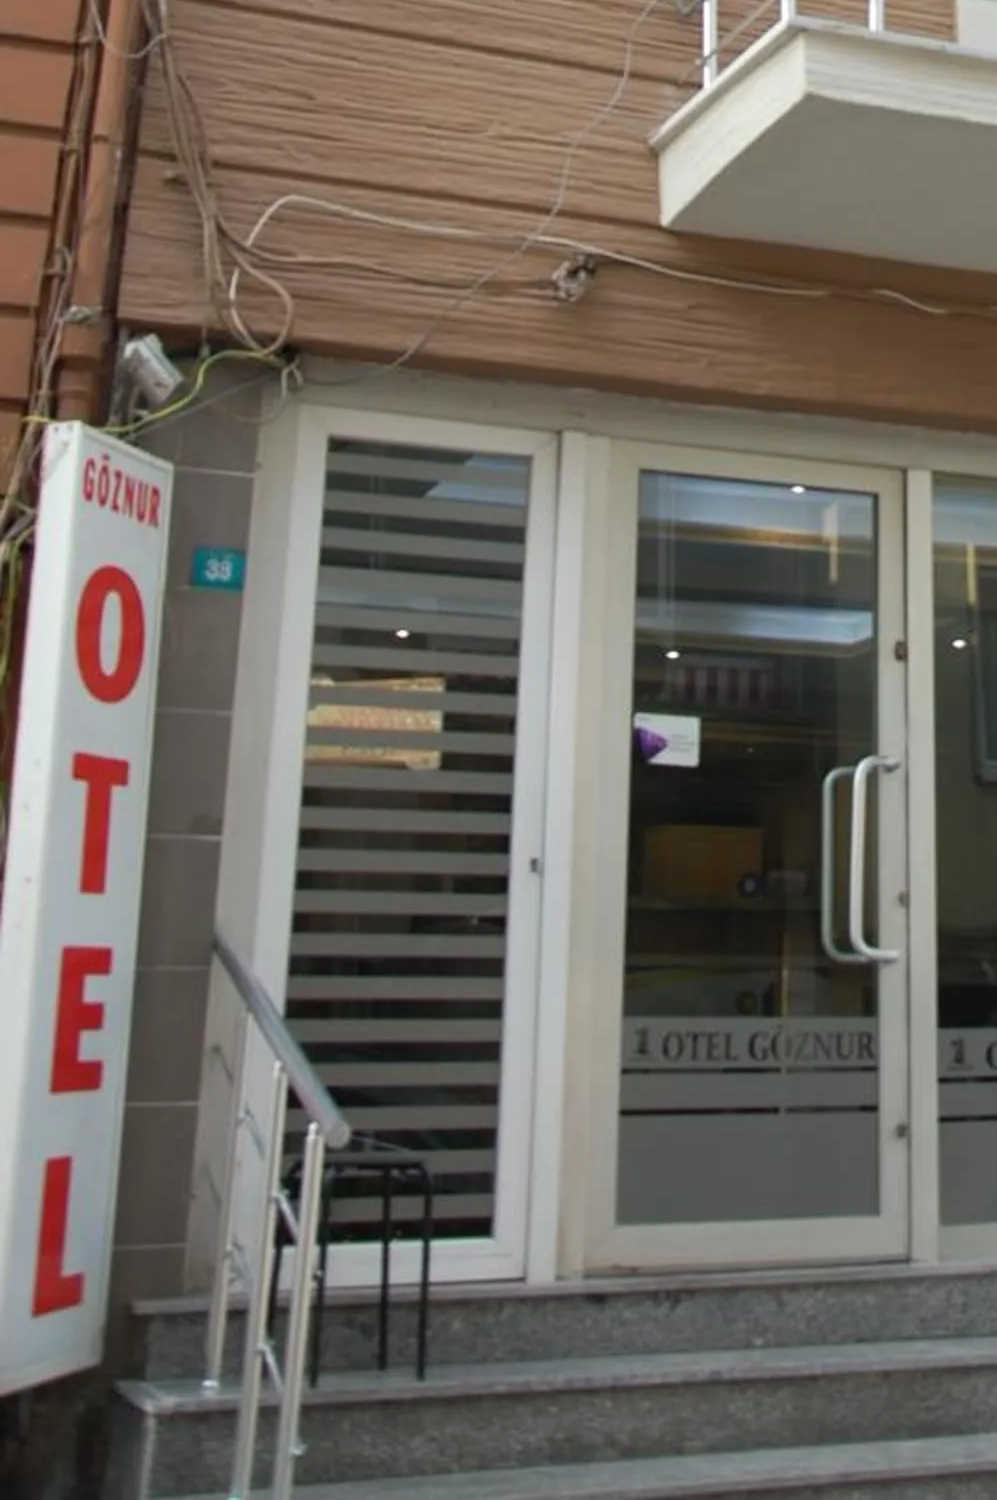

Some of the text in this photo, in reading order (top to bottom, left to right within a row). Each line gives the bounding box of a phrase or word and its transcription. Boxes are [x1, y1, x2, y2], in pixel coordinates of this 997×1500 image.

[82, 454, 161, 528] GÖZNUR
[31, 565, 146, 1318] OTEL
[662, 1024, 876, 1061] OTEL GÖZNUR
